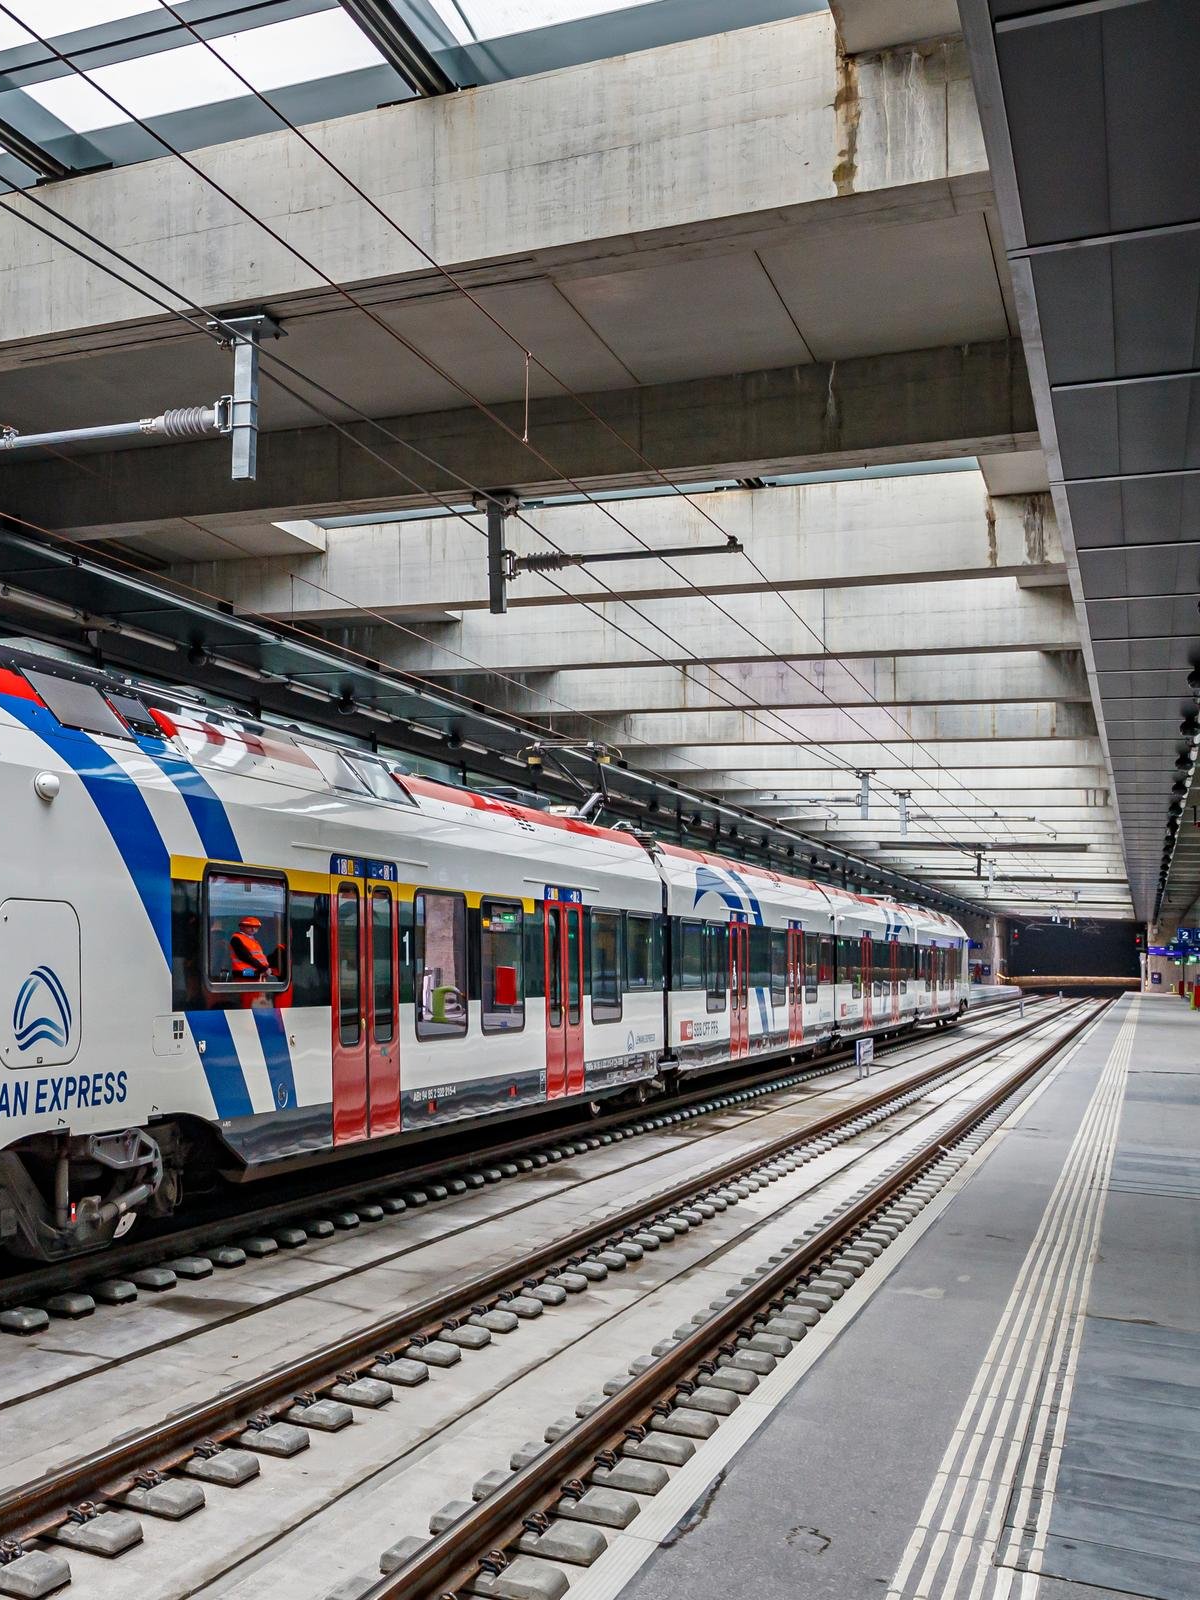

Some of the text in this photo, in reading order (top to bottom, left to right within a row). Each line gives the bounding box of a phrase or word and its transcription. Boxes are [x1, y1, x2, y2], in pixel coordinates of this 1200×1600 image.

[336, 858, 340, 874] 1
[306, 925, 314, 965] 1
[402, 931, 410, 966] 1
[1182, 931, 1189, 939] 2
[35, 1071, 127, 1114] EXPRESS
